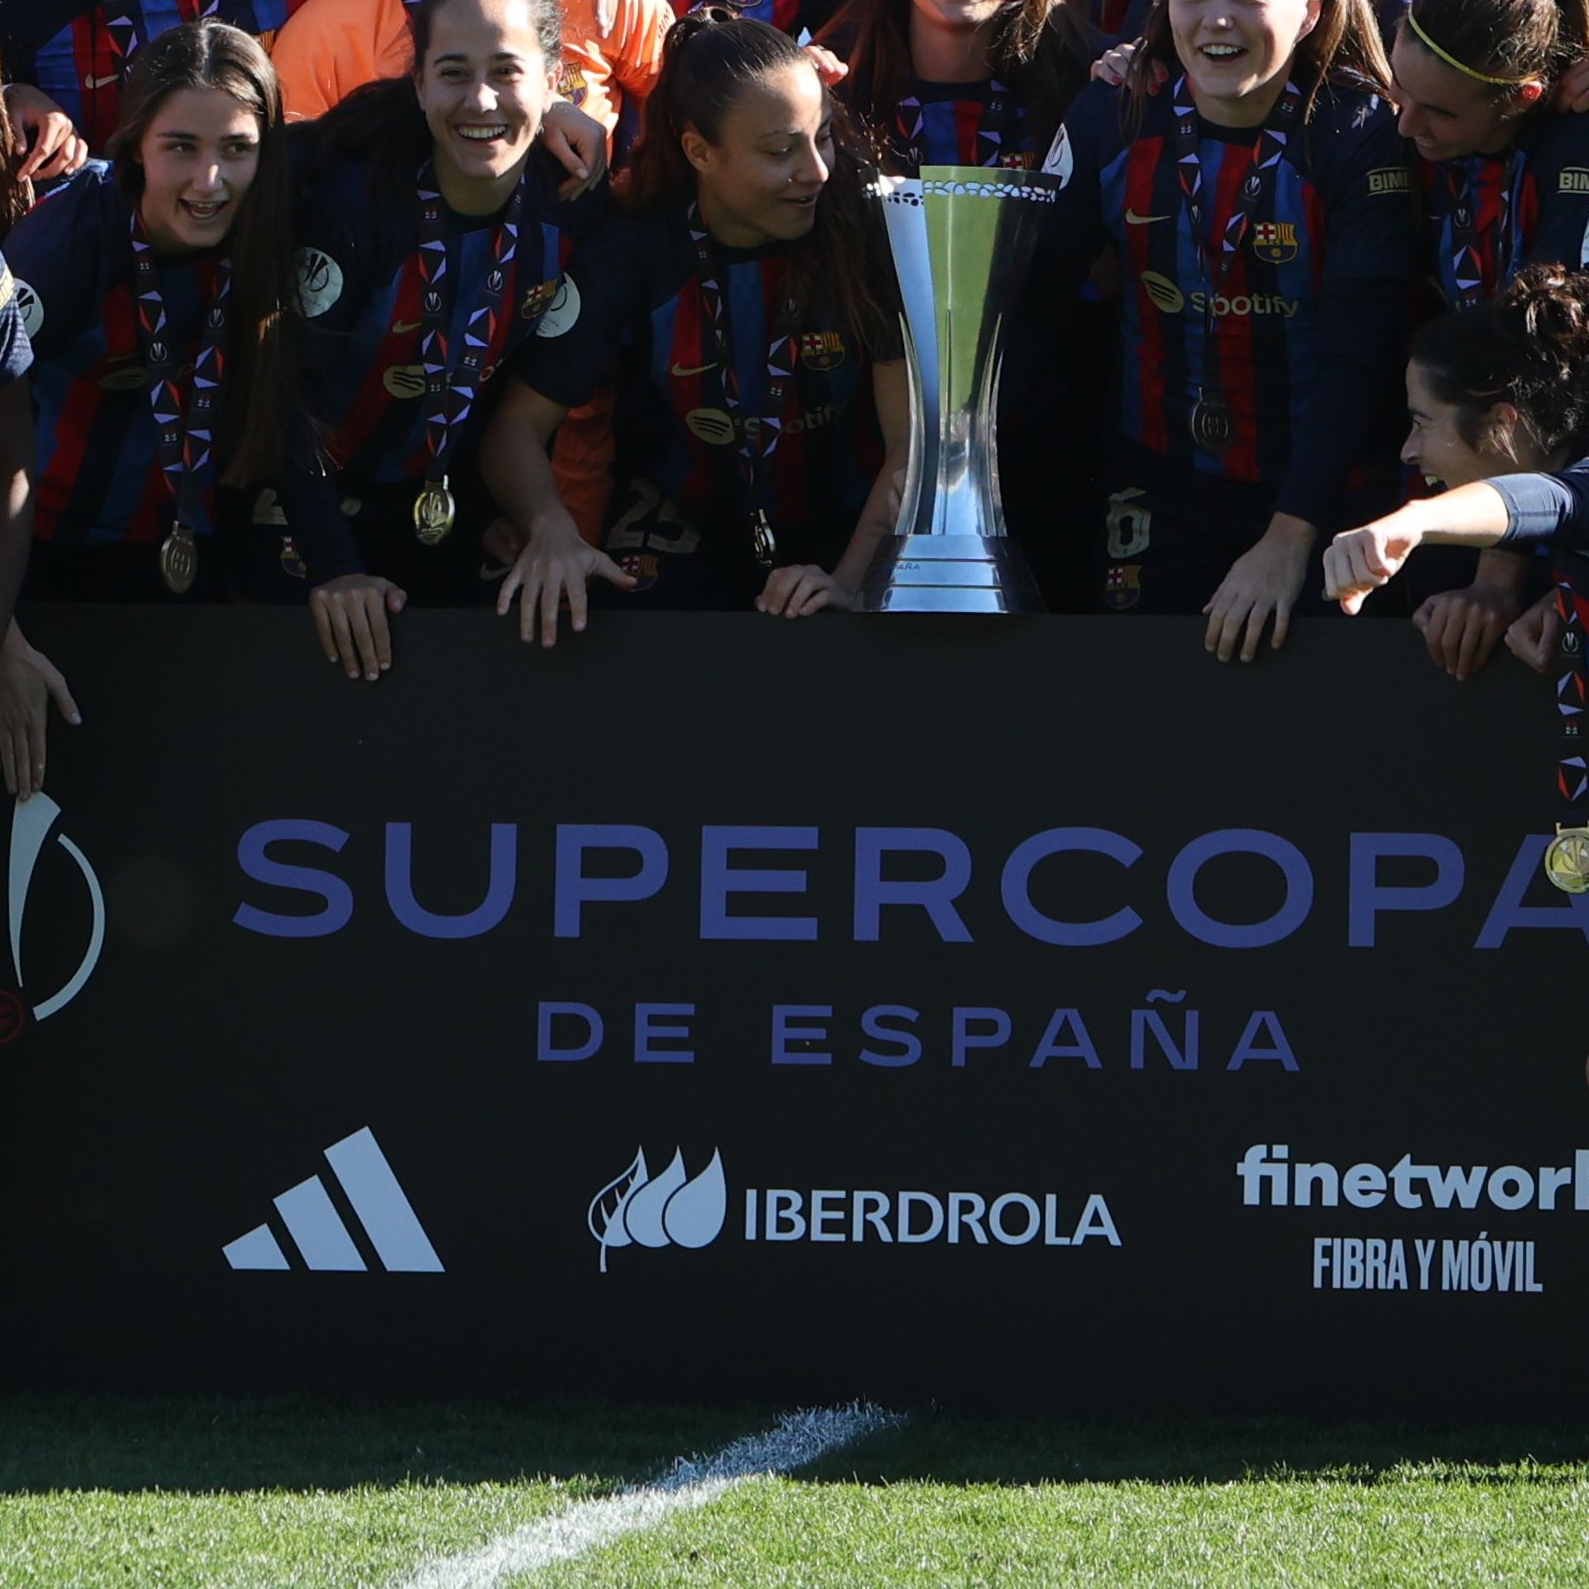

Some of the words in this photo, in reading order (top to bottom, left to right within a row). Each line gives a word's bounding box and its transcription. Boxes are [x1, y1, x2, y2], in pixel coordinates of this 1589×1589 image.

[1192, 291, 1299, 319] Spotify
[537, 1001, 696, 1063] DE
[771, 989, 1300, 1072] ESPAÑA
[745, 1188, 1122, 1246] IBERDROLA
[1313, 1237, 1408, 1290] FIBRA
[1414, 1239, 1436, 1290] Y
[1442, 1229, 1543, 1292] MÓVIL
